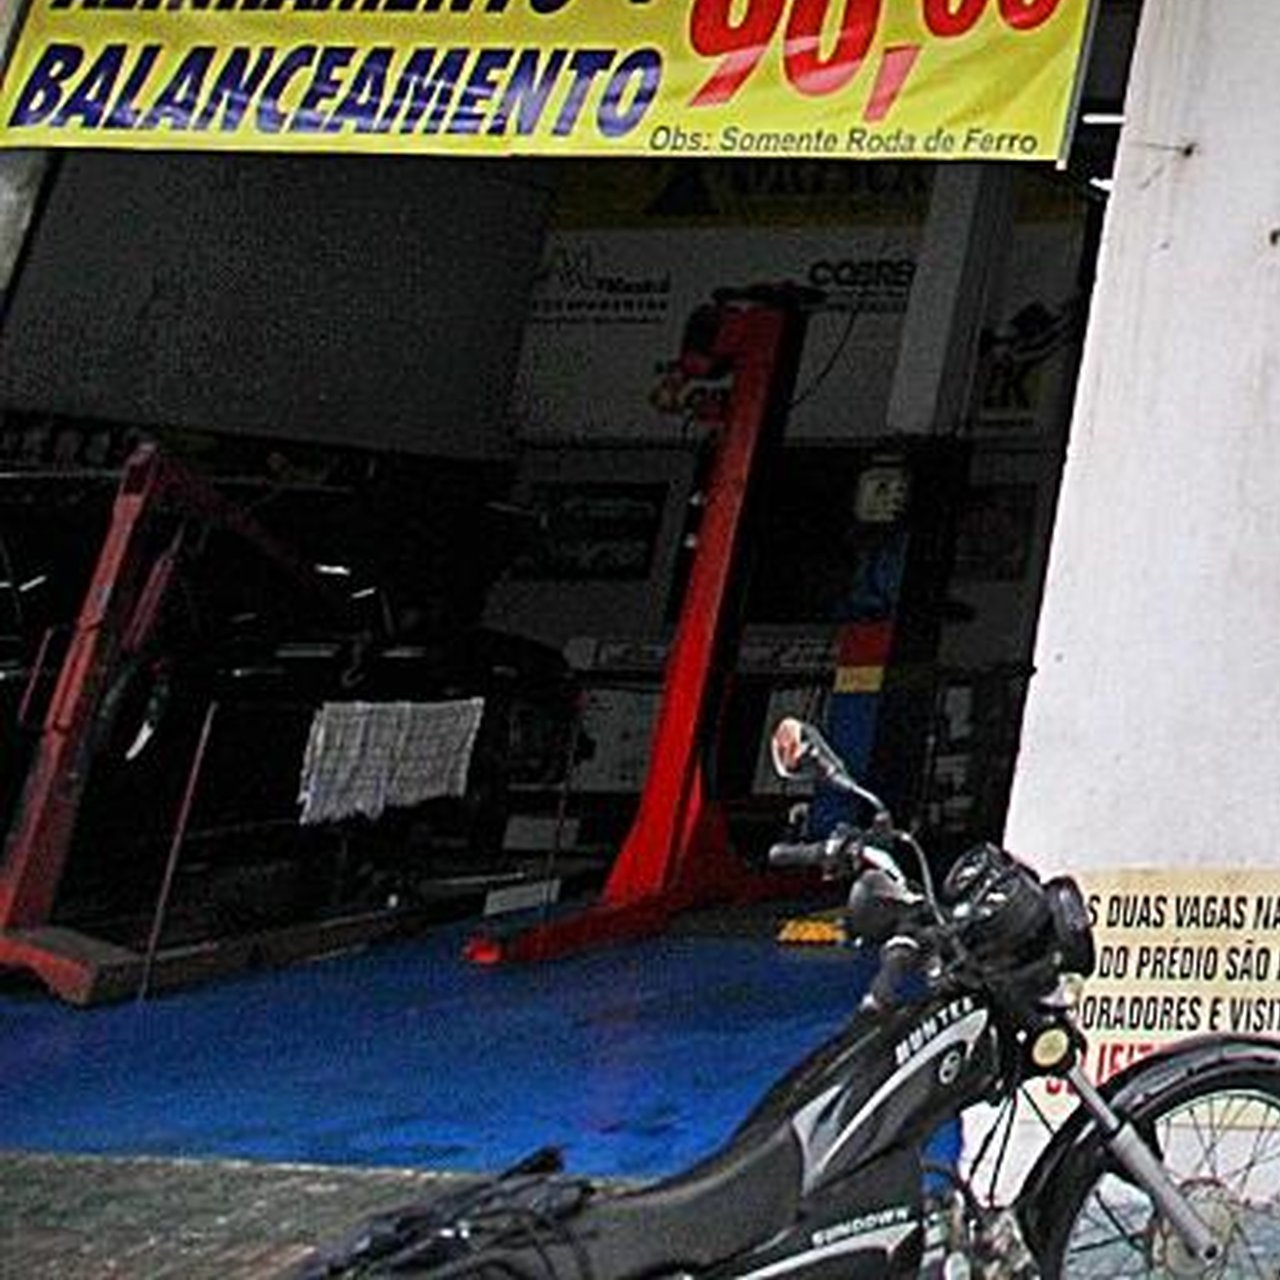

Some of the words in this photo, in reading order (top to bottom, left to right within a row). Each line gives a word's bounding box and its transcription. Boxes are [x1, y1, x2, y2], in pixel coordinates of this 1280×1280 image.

[9, 42, 662, 138] BALANCEAMENTO
[649, 125, 711, 152] Obs:
[720, 126, 838, 153] Somente
[846, 128, 916, 153] Roda
[923, 128, 955, 153] de
[962, 129, 1039, 155] Ferro
[1105, 894, 1168, 929] DUAS
[1175, 895, 1248, 930] VAGAS
[1099, 945, 1130, 980] DO
[1135, 937, 1219, 981] PRÉDIO
[1225, 938, 1272, 982] SÃO
[1081, 995, 1202, 1032] ORADORES
[1209, 996, 1224, 1032] E
